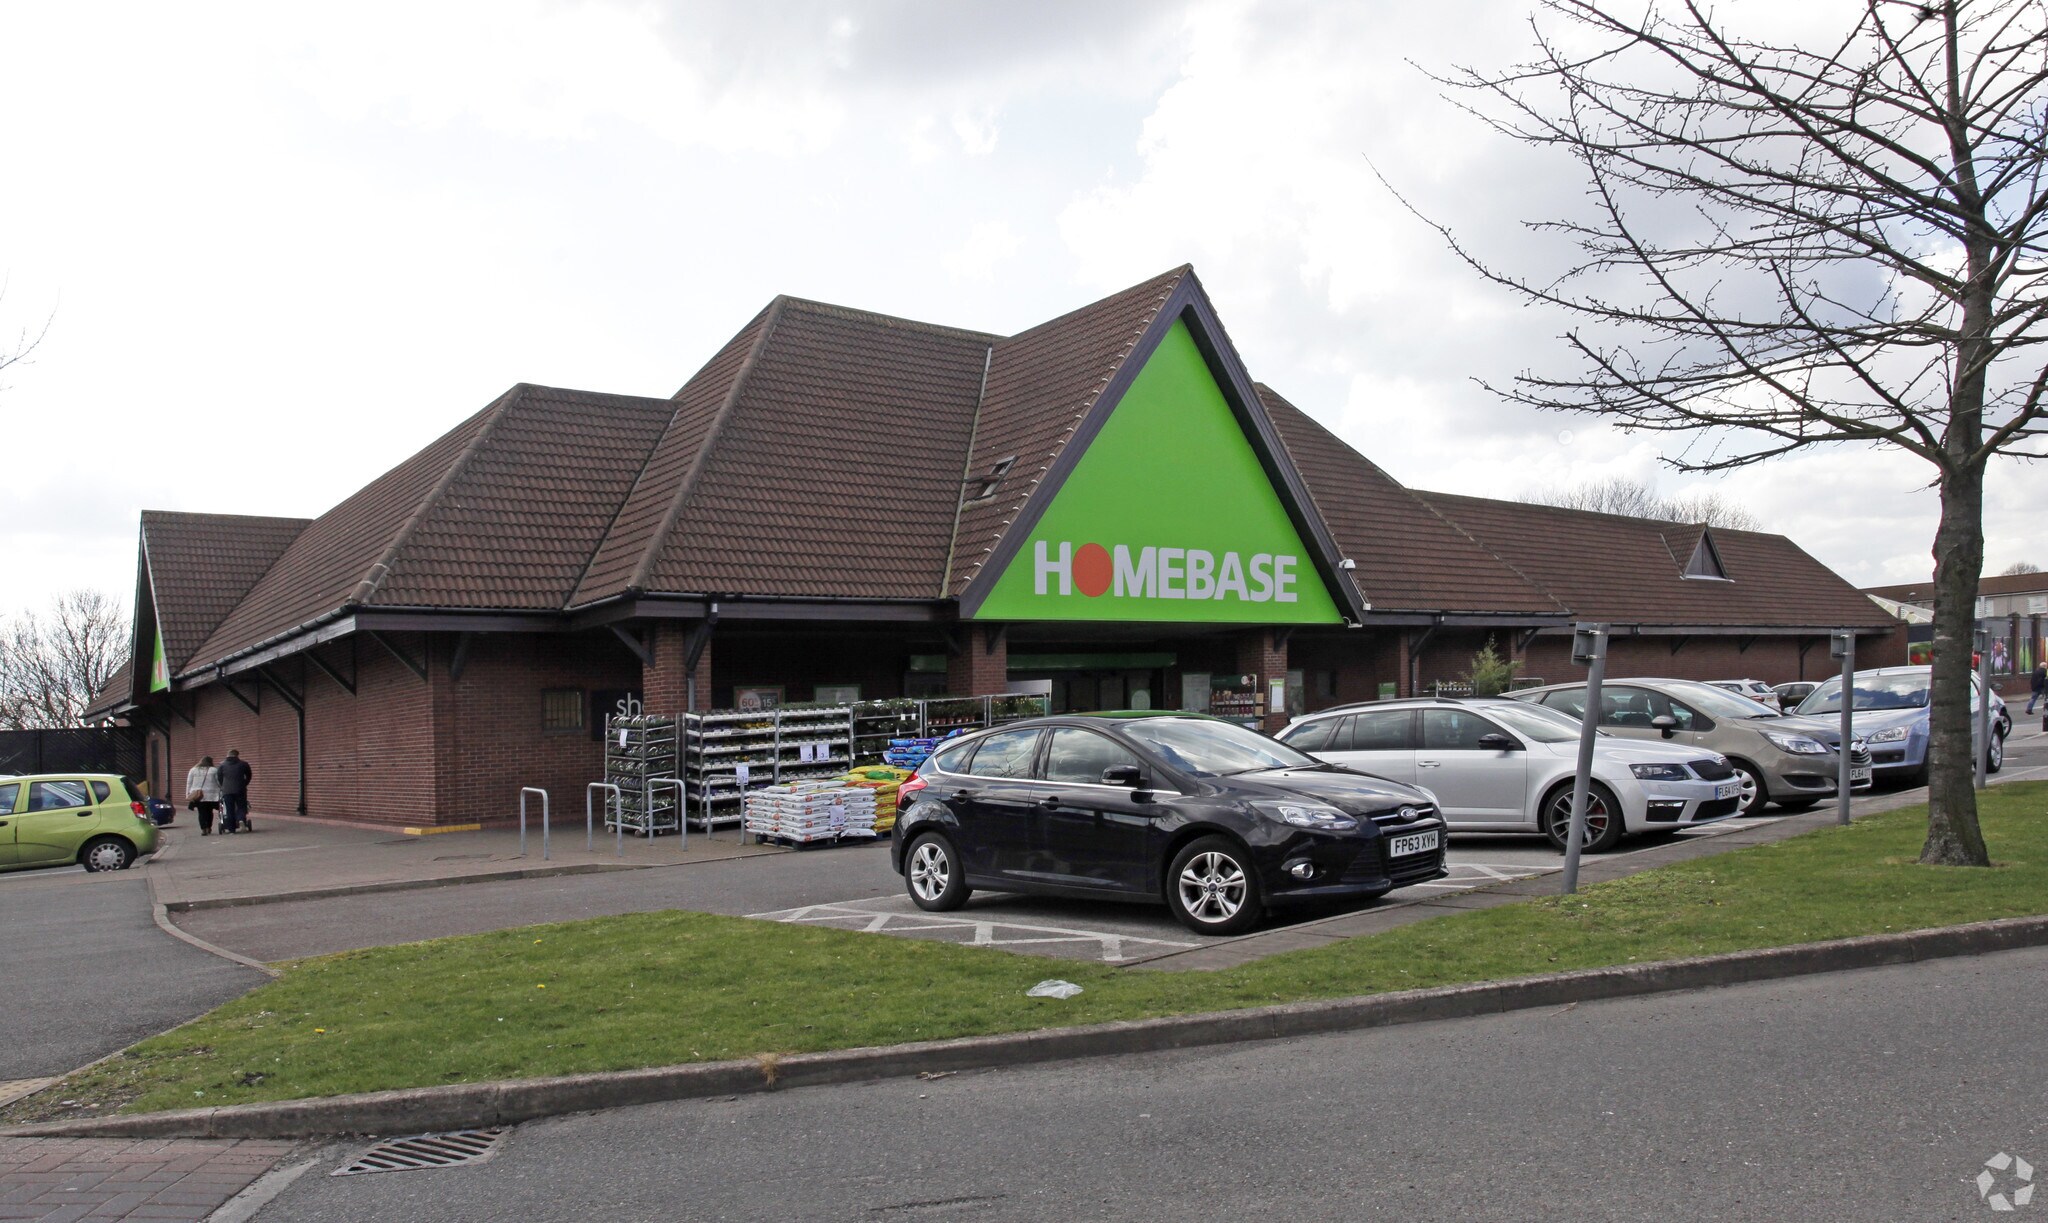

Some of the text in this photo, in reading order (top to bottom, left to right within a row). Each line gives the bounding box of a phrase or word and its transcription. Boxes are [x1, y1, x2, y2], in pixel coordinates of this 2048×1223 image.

[1034, 540, 1297, 602] HOMEBASE
[616, 692, 644, 717] sh
[1395, 833, 1436, 854] FP63 XYH
